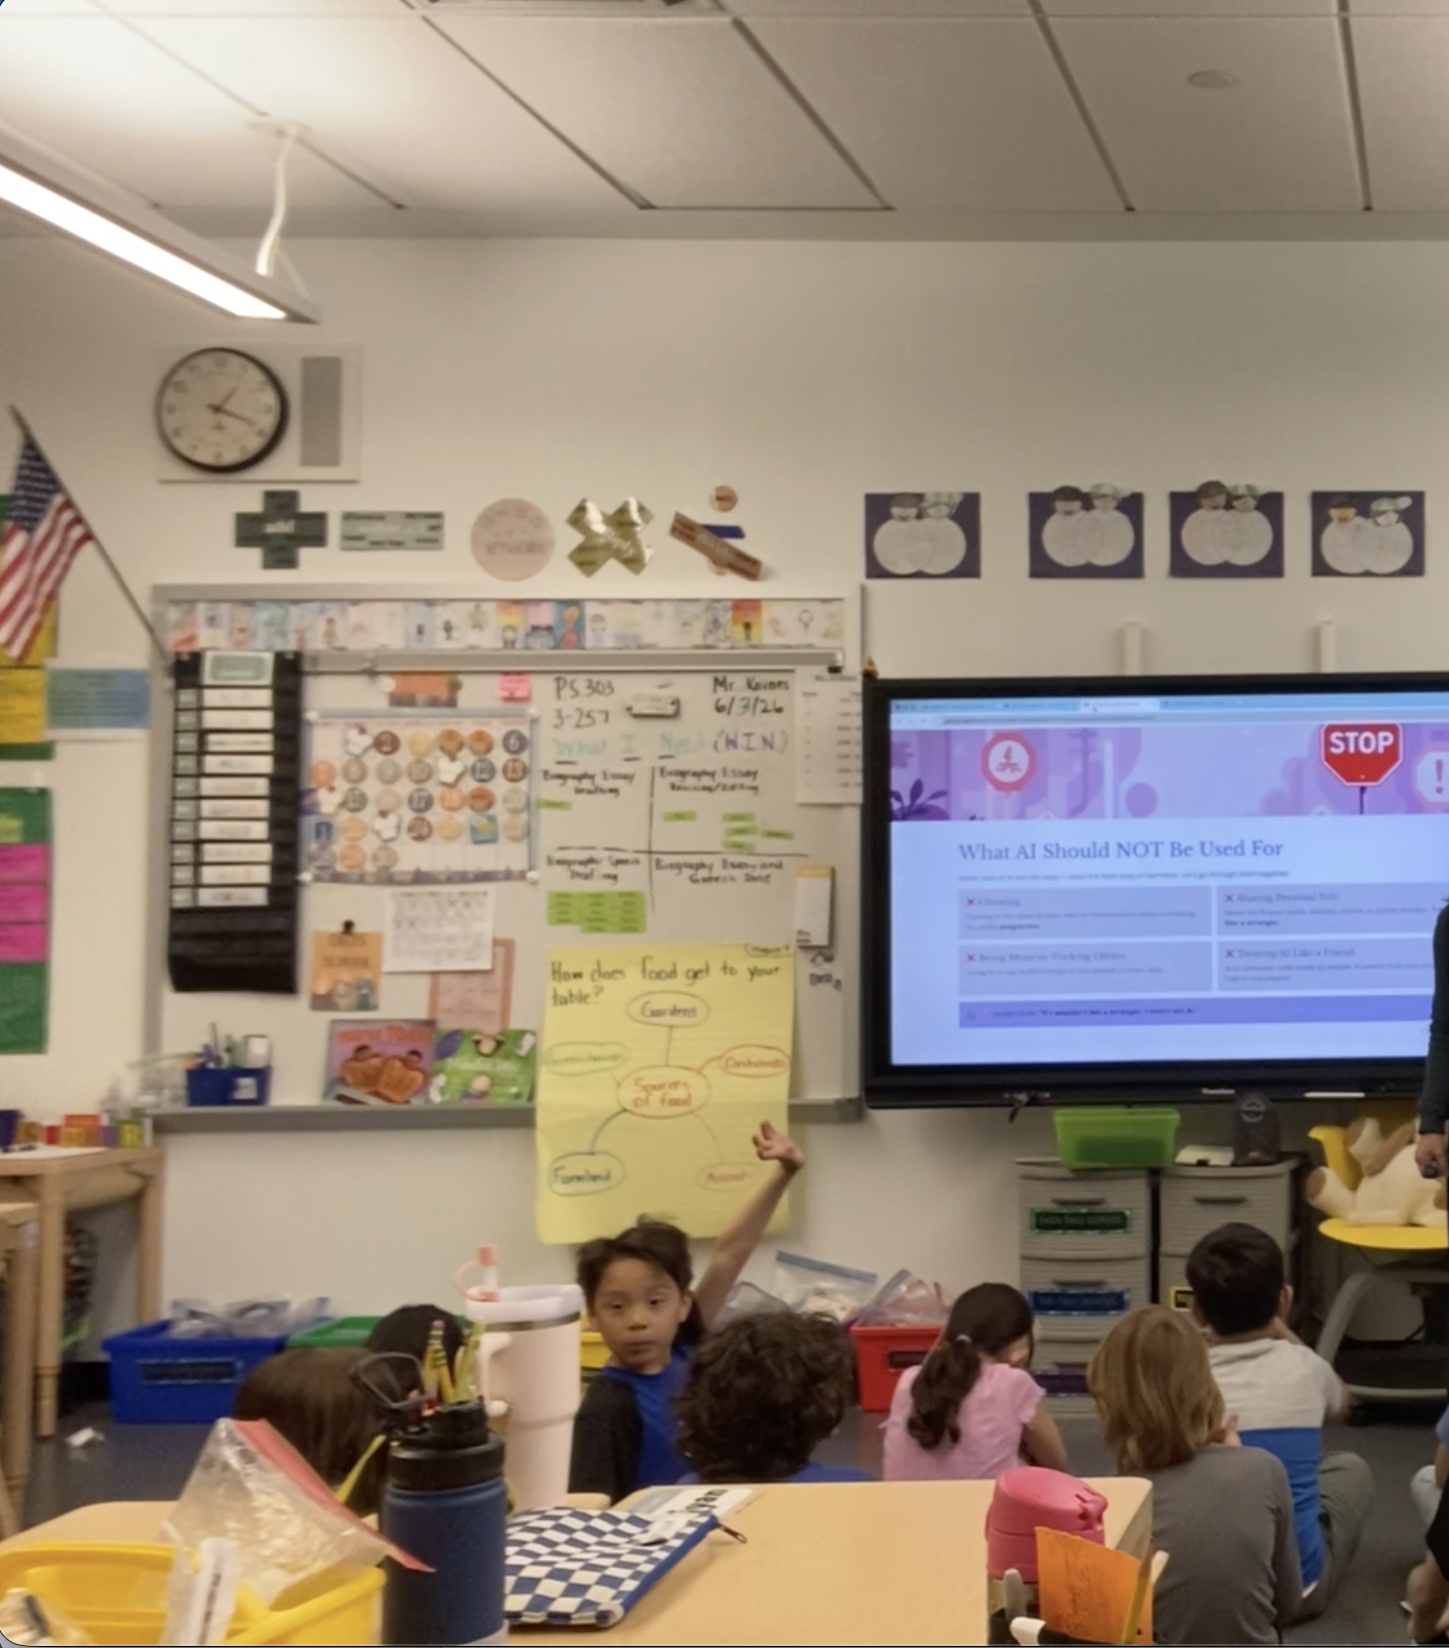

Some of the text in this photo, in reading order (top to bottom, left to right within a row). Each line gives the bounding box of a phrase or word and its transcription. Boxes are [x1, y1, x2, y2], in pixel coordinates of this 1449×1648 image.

[585, 679, 615, 697] 303
[715, 696, 784, 716] 6/3/26
[553, 707, 609, 728] 3-257
[509, 733, 519, 750] 6
[1329, 731, 1395, 754] STOP
[476, 762, 491, 778] 12
[508, 762, 523, 779] 13
[414, 792, 430, 808] 17
[958, 839, 1284, 860] What AI Should NOT Be Used For
[1237, 891, 1341, 904] Sharing Personal Info
[979, 954, 1006, 964] Being
[1050, 951, 1091, 963] Tricking
[1094, 951, 1127, 961] Others
[1237, 948, 1277, 959] Treating
[1280, 948, 1291, 957] AI
[1293, 947, 1313, 958] Like
[1324, 946, 1356, 957] Friend
[551, 956, 780, 986] How does food get to your
[552, 985, 605, 1007] table?
[660, 1092, 692, 1108] food
